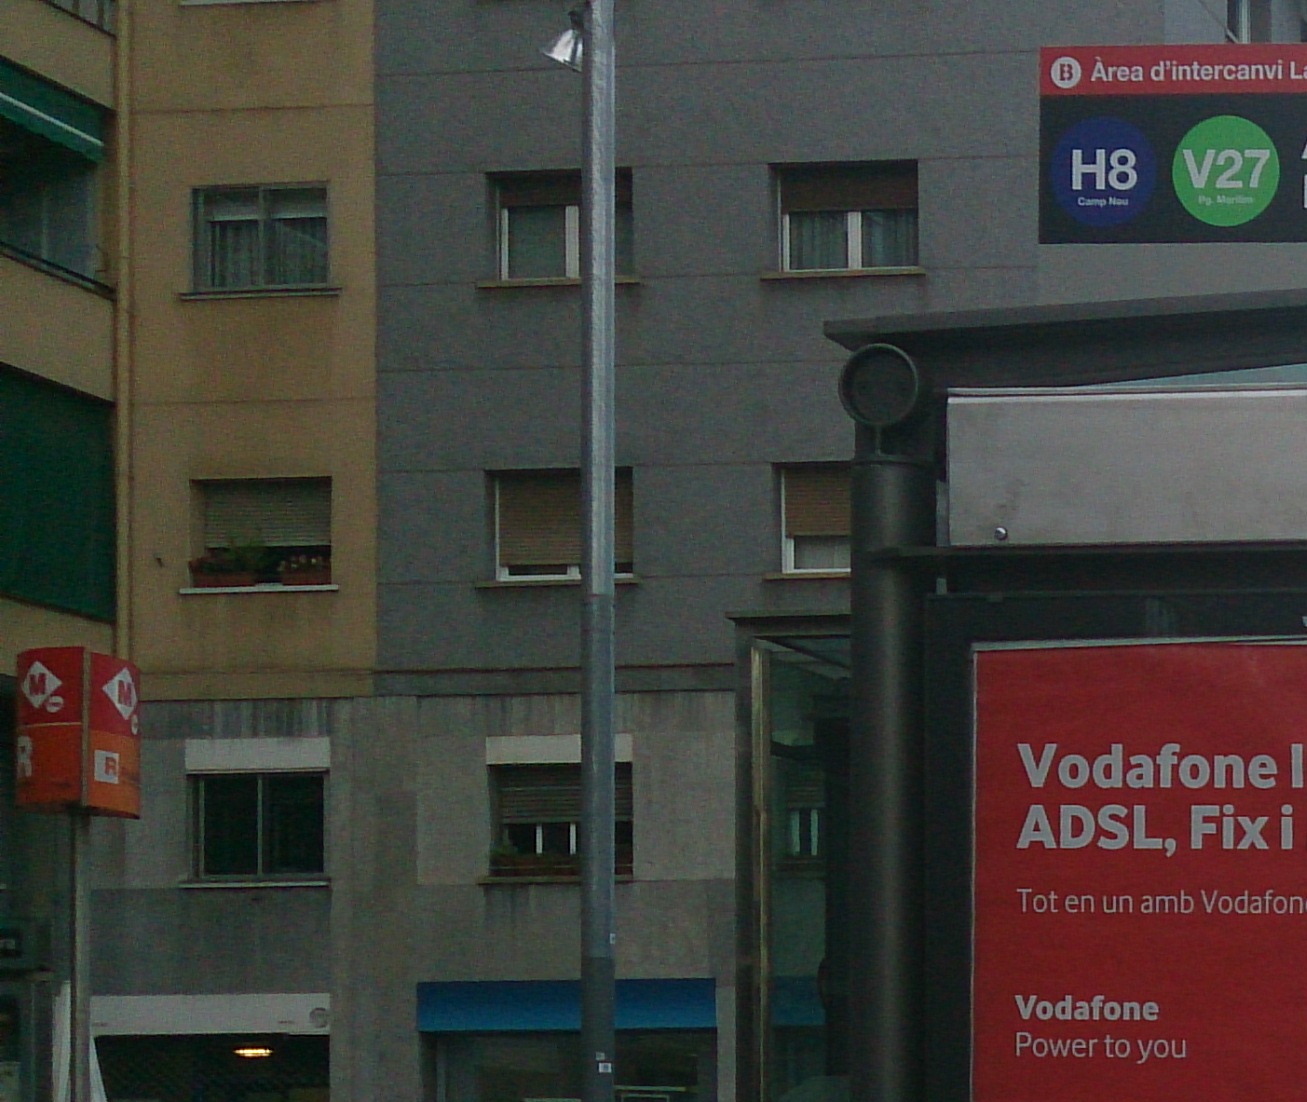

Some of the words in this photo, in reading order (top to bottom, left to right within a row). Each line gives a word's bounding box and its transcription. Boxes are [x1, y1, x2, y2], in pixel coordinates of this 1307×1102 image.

[1091, 57, 1144, 82] Àrea
[1071, 148, 1138, 192] H8
[1182, 148, 1271, 190] V27
[1077, 196, 1107, 207] Camp
[29, 672, 47, 696] M
[117, 680, 133, 708] M
[1017, 743, 1278, 789] Vodafone
[1015, 804, 1177, 856] ADSL,
[1190, 805, 1270, 851] Fix
[1279, 804, 1294, 850] i
[1016, 888, 1059, 915] Tot
[1064, 894, 1095, 915] en
[1102, 894, 1133, 915] un
[1140, 889, 1194, 915] amb
[1015, 994, 1160, 1022] Vodafone
[1015, 1032, 1098, 1059] Power
[1103, 1035, 1130, 1059] to
[1135, 1038, 1188, 1065] you
